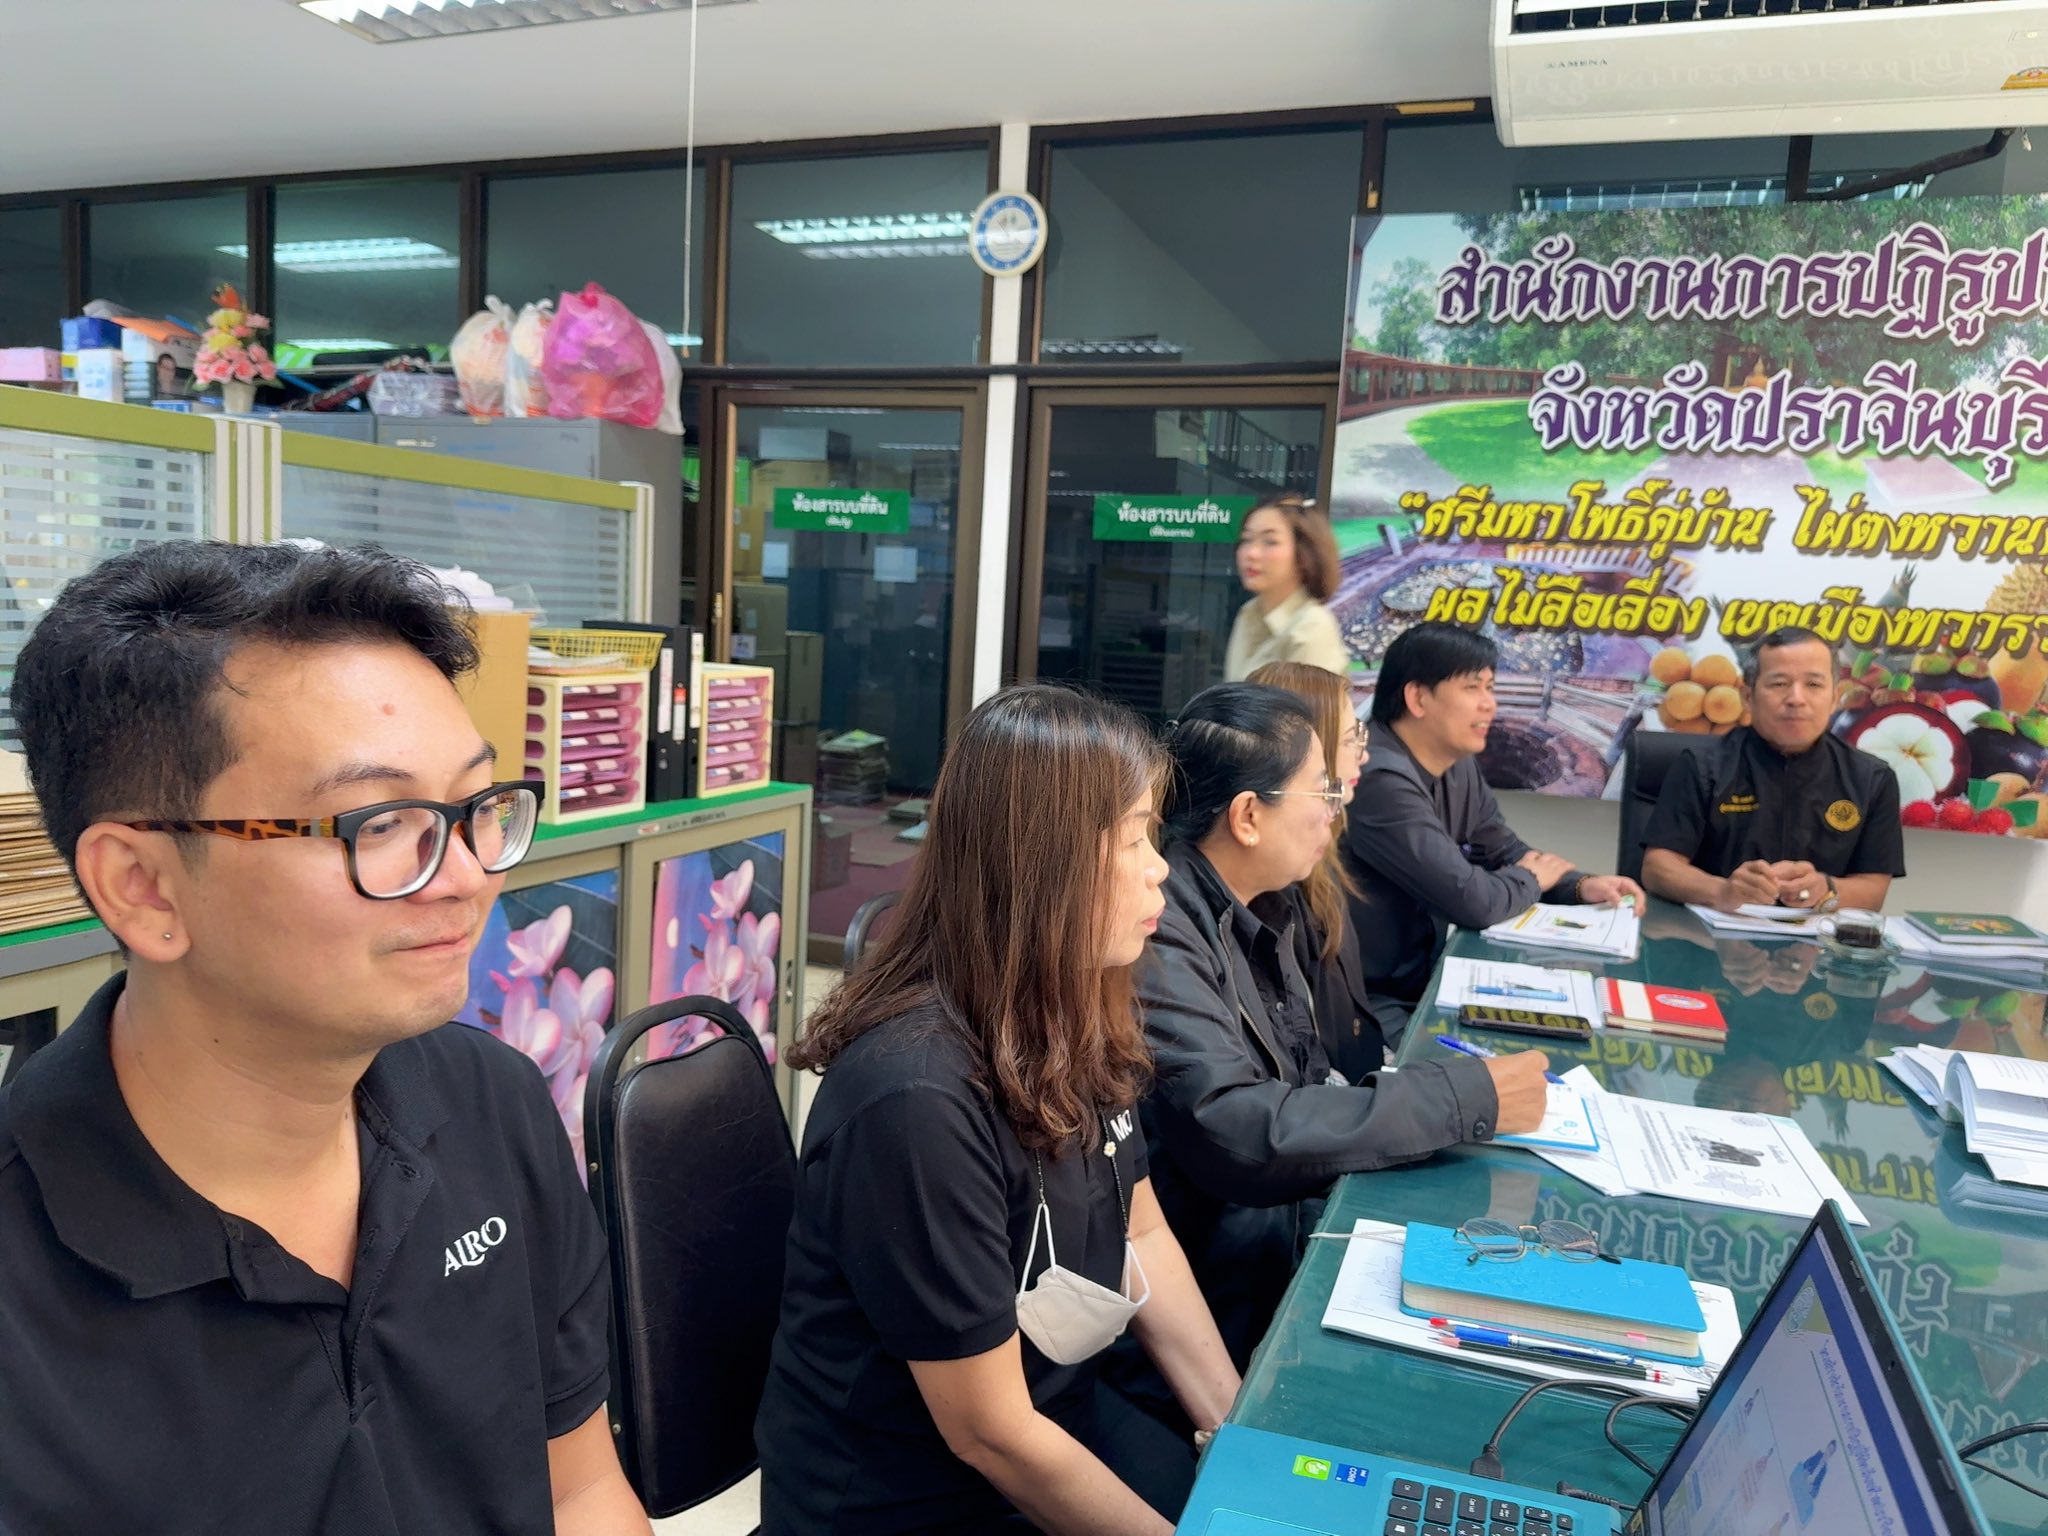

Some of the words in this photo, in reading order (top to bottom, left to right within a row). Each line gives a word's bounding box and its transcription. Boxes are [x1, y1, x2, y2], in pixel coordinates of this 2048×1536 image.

[1436, 221, 2048, 346] สำนักงานการปฏิรูป
[1117, 499, 1231, 524] ห้องสารบบที่ดิน
[1793, 485, 2048, 562] ไผ่ตงหวาน
[1423, 566, 1707, 637] ผลไม้ลือเลื่อง
